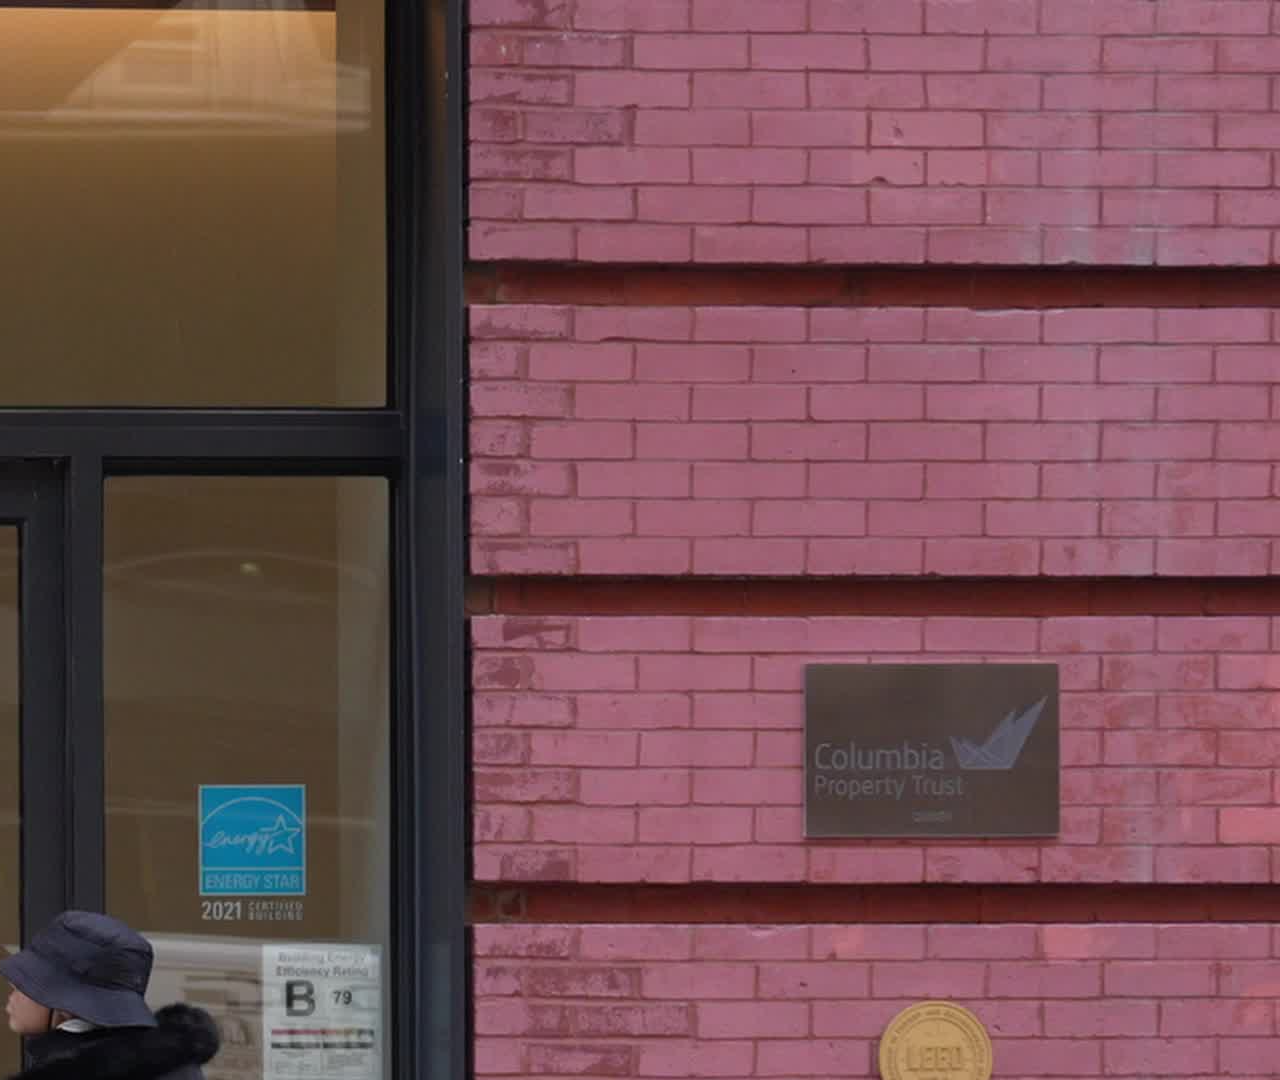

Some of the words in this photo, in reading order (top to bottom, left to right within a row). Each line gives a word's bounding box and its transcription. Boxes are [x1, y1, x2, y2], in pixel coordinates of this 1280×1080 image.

[814, 740, 945, 771] Columbia
[814, 775, 906, 801] Property
[911, 775, 964, 797] Trust
[205, 873, 259, 889] ENERGY
[263, 873, 300, 889] STAR
[200, 901, 242, 920] 2021
[275, 965, 330, 978] Efficiency
[285, 979, 317, 1016] B
[332, 989, 353, 1006] 79
